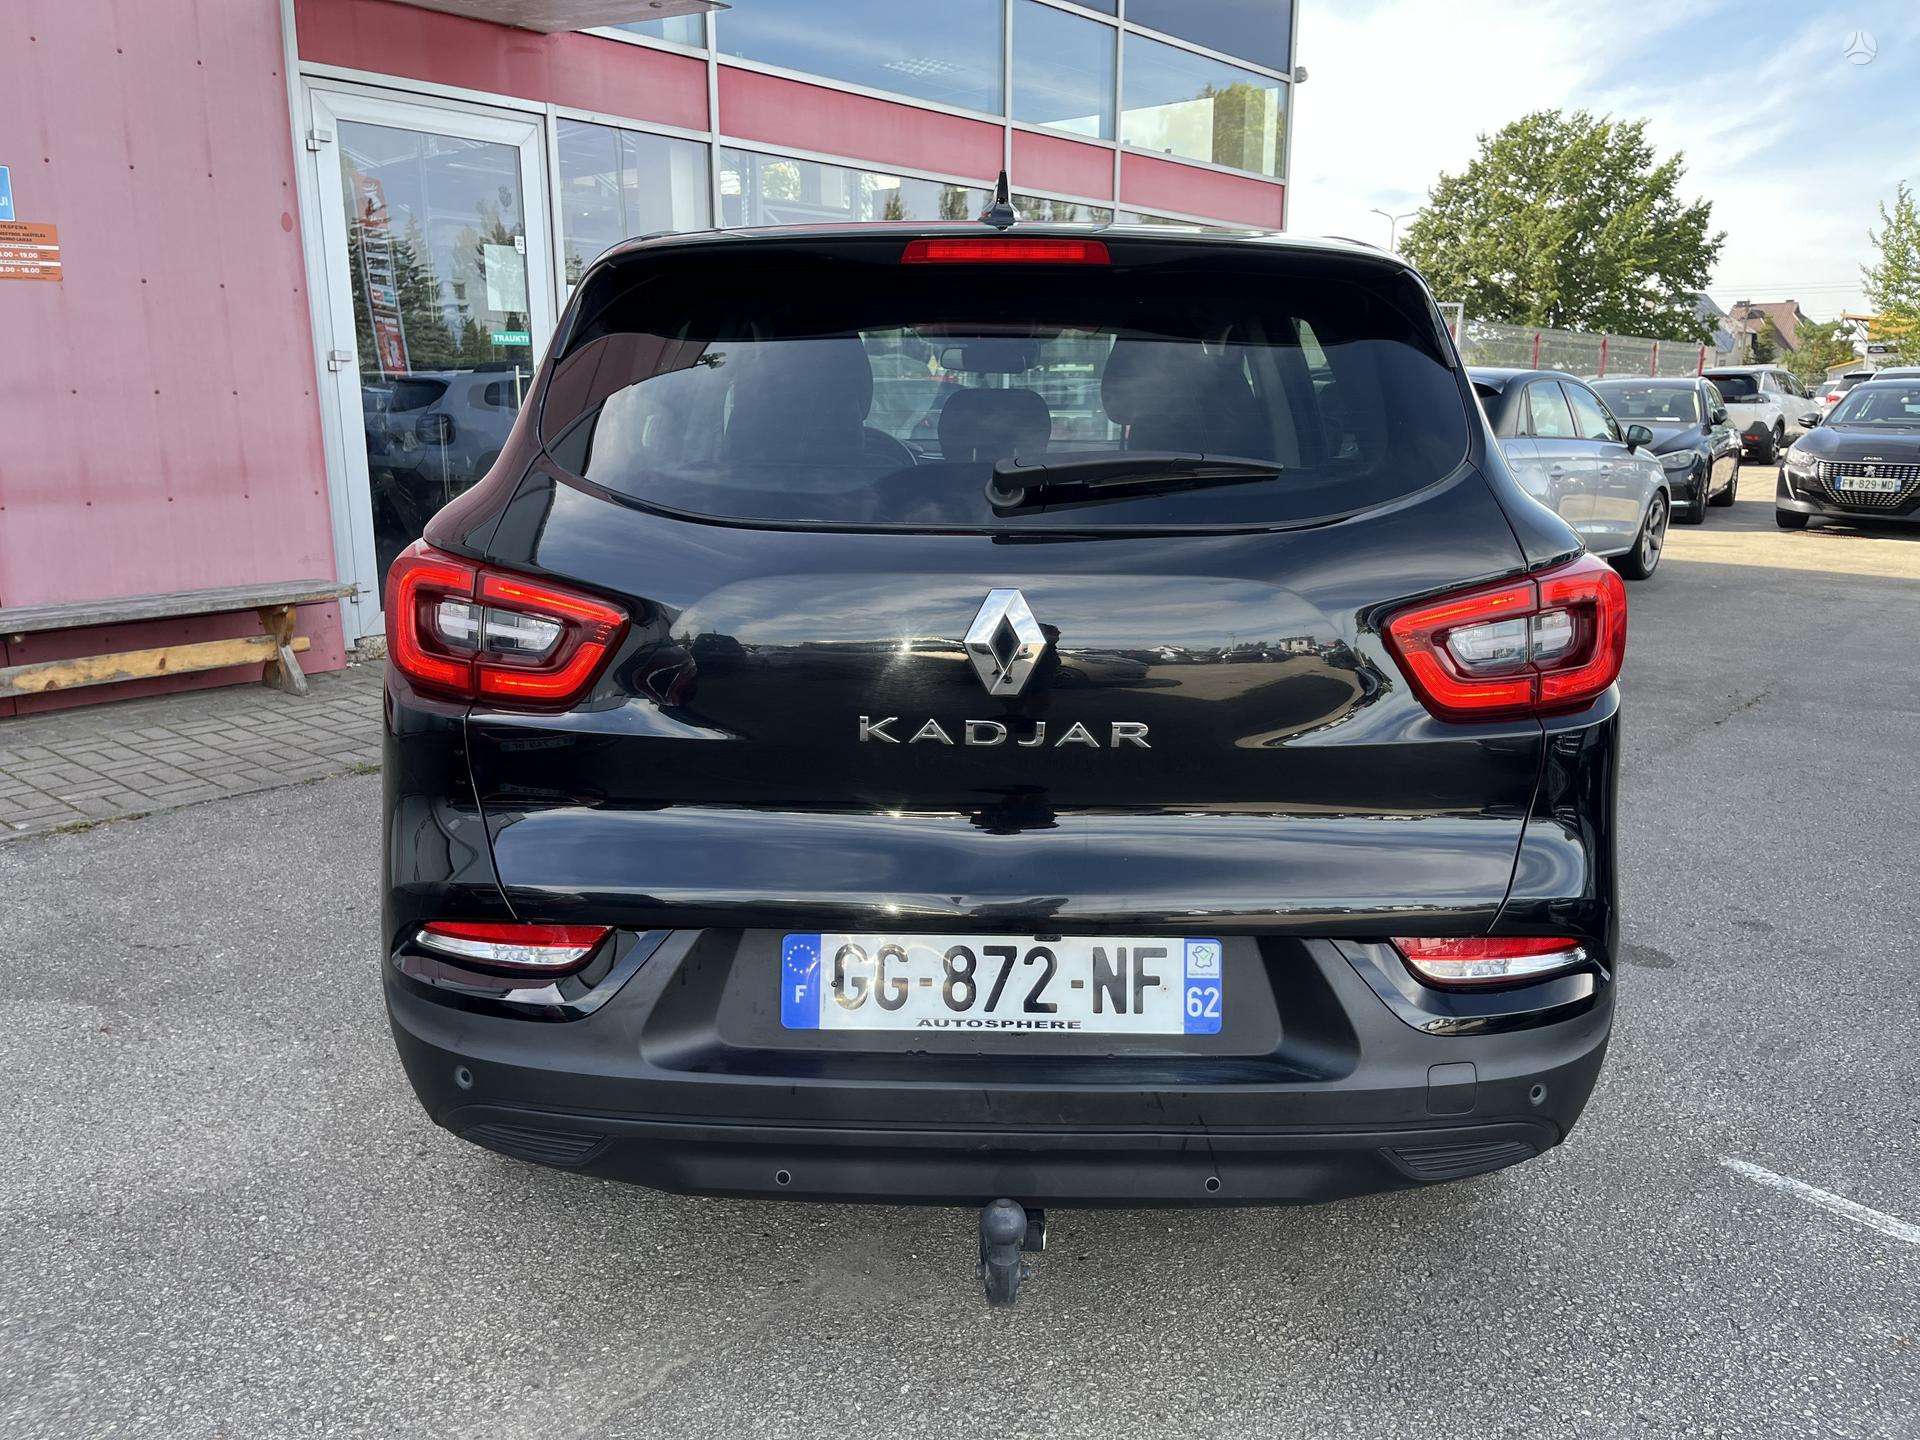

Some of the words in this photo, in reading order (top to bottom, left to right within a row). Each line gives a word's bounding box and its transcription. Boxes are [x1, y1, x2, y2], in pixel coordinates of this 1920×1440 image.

[493, 334, 528, 343] TRAUKTI
[859, 716, 1152, 748] KADJAR
[834, 943, 1168, 1015] GG-872-NF
[795, 985, 808, 1003] F
[1186, 987, 1220, 1018] 62
[916, 1018, 1082, 1030] AUTOSPHERE
